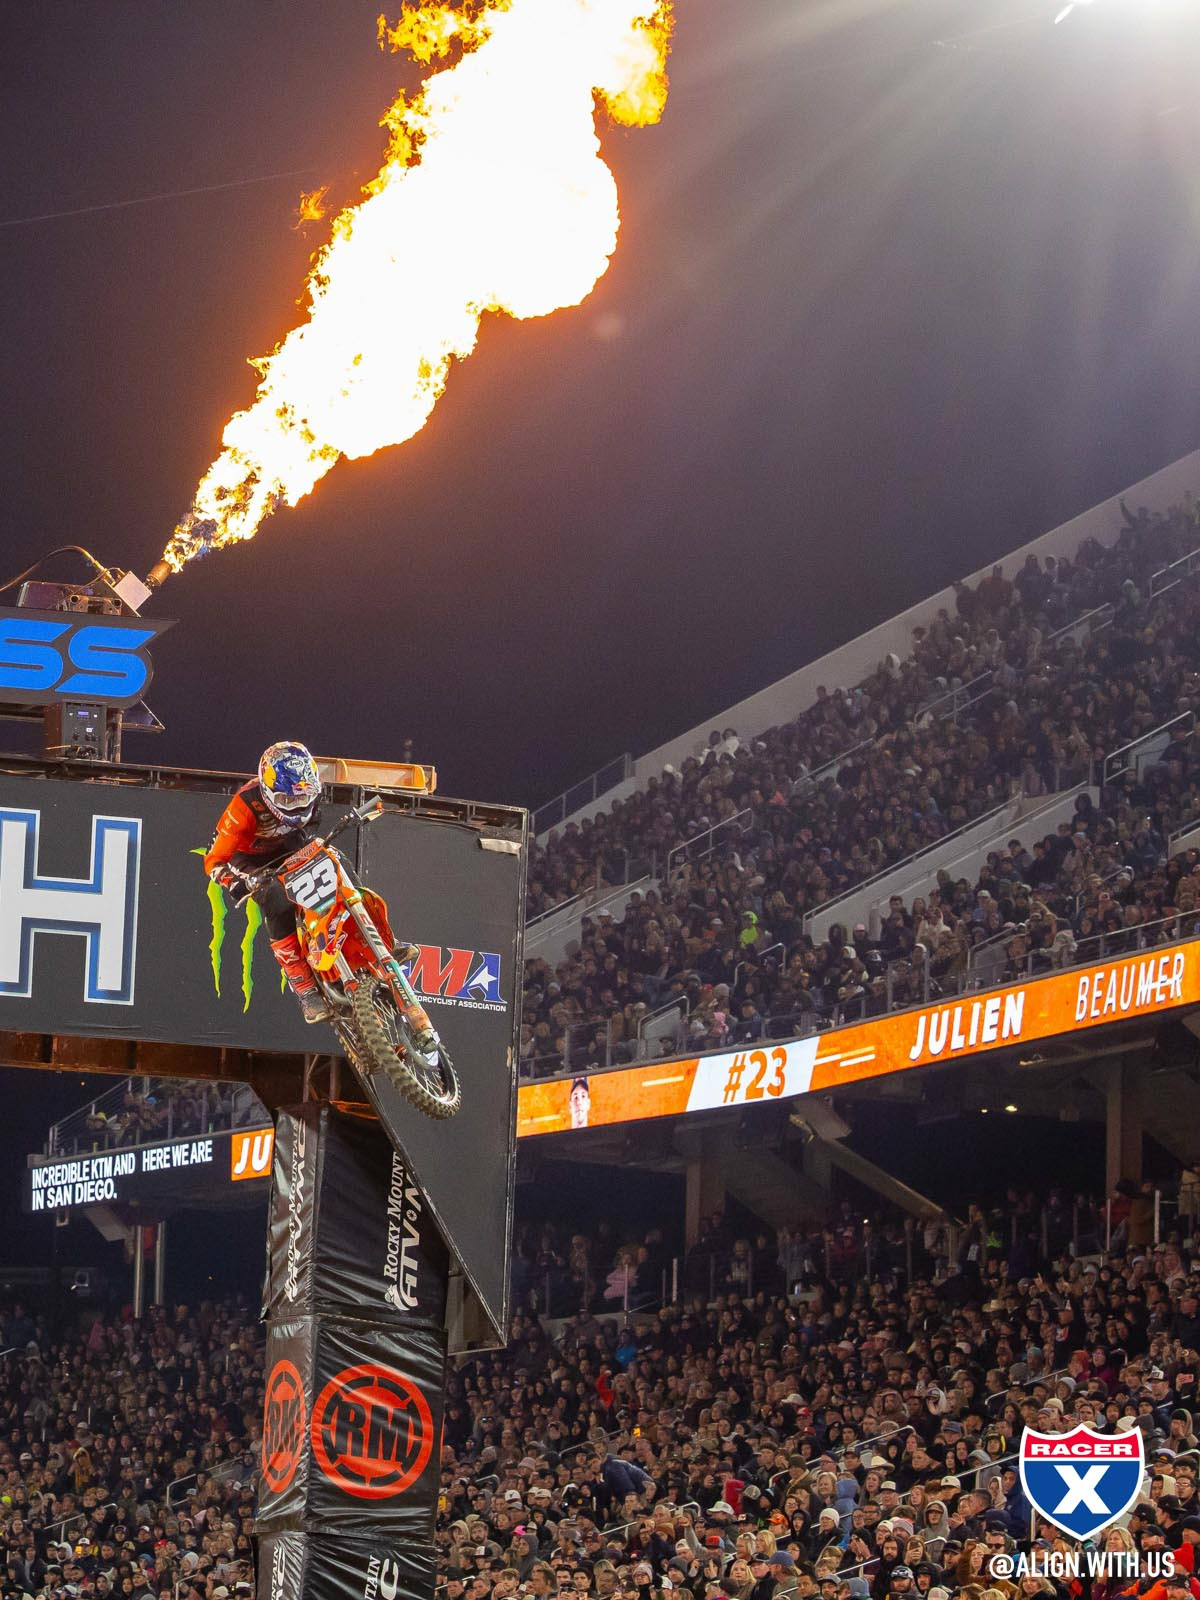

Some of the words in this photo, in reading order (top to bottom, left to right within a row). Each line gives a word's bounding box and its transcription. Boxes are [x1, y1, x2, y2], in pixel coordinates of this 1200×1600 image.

[291, 858, 338, 909] 23
[416, 995, 457, 1006] ORCYCLIST
[458, 1001, 507, 1012] ASSOCIATION
[909, 991, 1025, 1060] JULIEN
[1075, 952, 1185, 1022] BEAUMER
[723, 1047, 787, 1103] #23
[32, 1160, 90, 1190] INCREDIBLE
[91, 1156, 113, 1180] KTM
[113, 1152, 136, 1177] AND
[142, 1146, 171, 1172] HERE
[172, 1143, 190, 1167] WE
[190, 1140, 213, 1165] ARE
[387, 1151, 405, 1220] MOUNT
[32, 1189, 44, 1211] IN
[46, 1185, 72, 1209] SAN
[75, 1178, 117, 1204] DIEGO.
[384, 1221, 400, 1281] ROCKY
